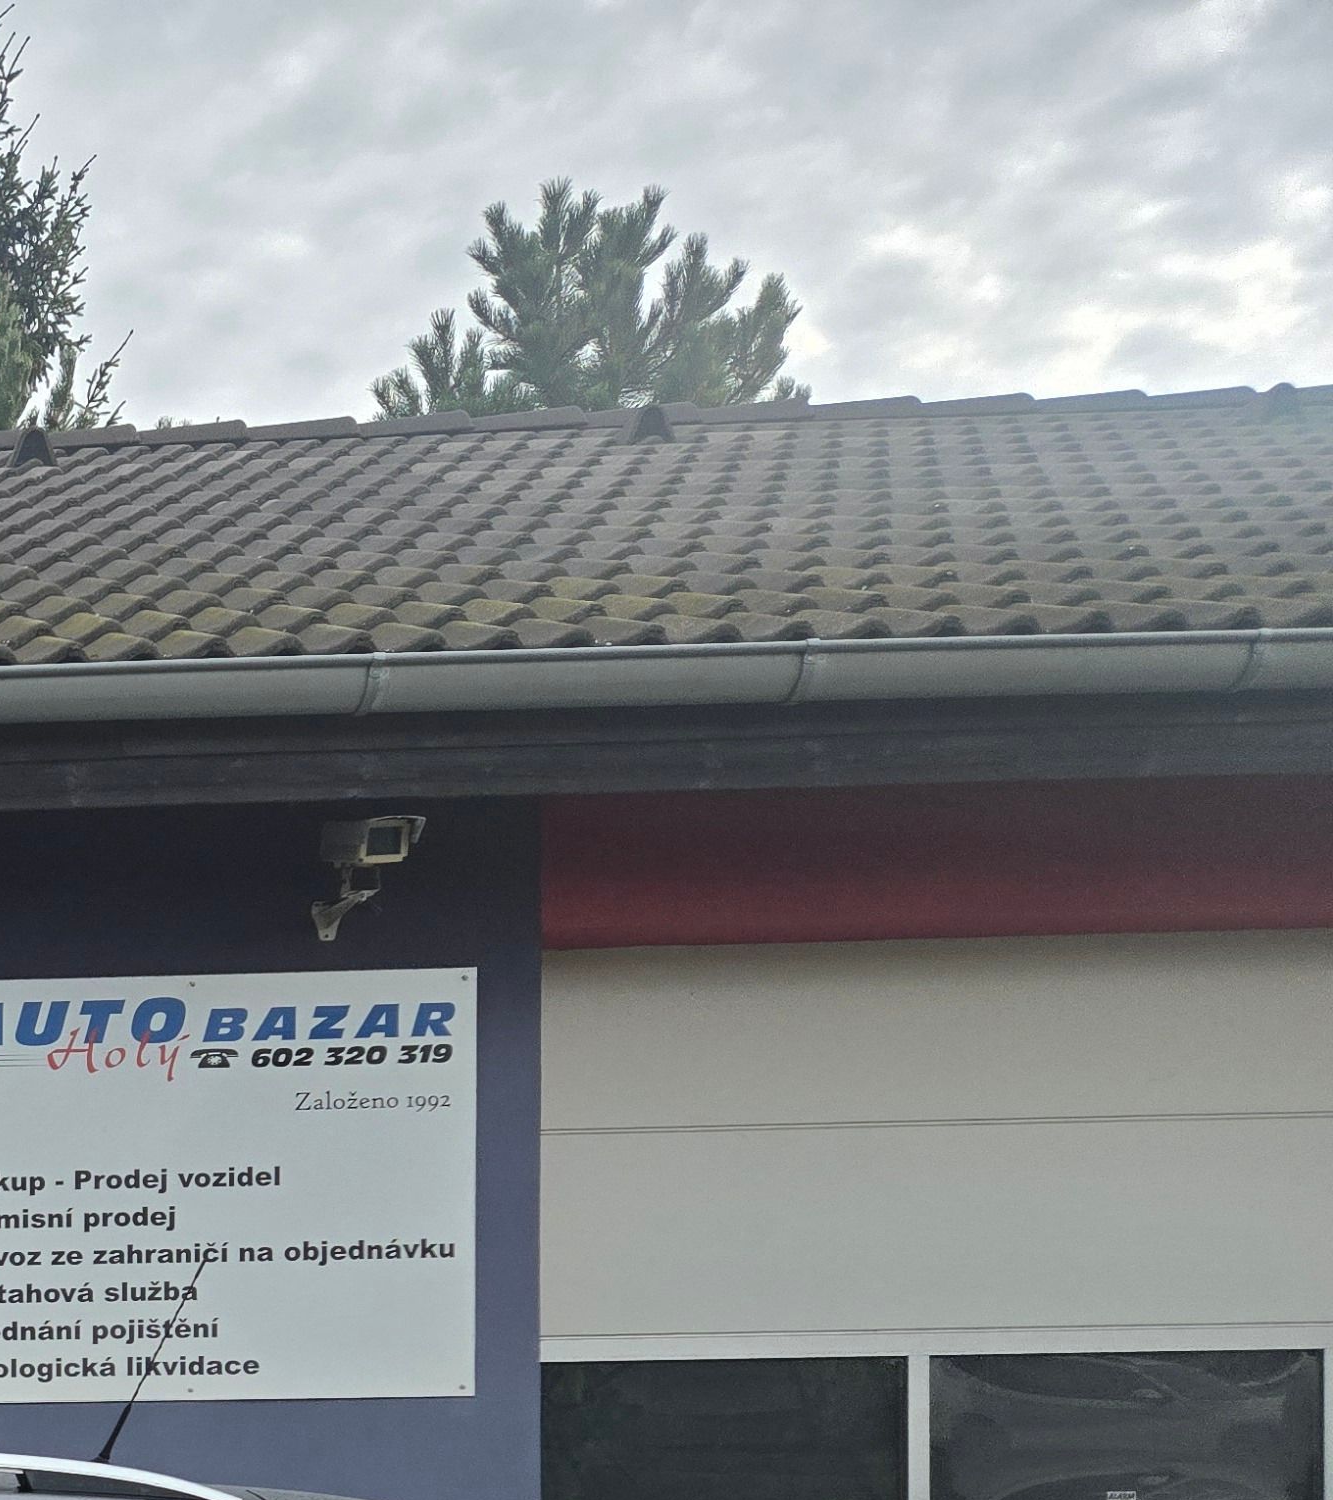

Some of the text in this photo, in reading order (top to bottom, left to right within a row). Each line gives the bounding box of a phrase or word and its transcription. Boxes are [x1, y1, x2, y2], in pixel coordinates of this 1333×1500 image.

[203, 1002, 456, 1042] BAZAR
[47, 1027, 190, 1082] Holý
[251, 1043, 454, 1067] 602 320 319
[295, 1091, 451, 1112] Založeno 1992
[74, 1169, 167, 1193] Prodej
[178, 1166, 281, 1187] vozidel
[84, 1206, 176, 1232] prodej
[51, 1251, 83, 1266] ze
[93, 1242, 228, 1265] zahraničí
[239, 1246, 273, 1262] na
[284, 1238, 455, 1266] objednávku
[104, 1281, 198, 1302] služba
[92, 1318, 220, 1344] pojištění
[127, 1355, 260, 1376] likvidace
